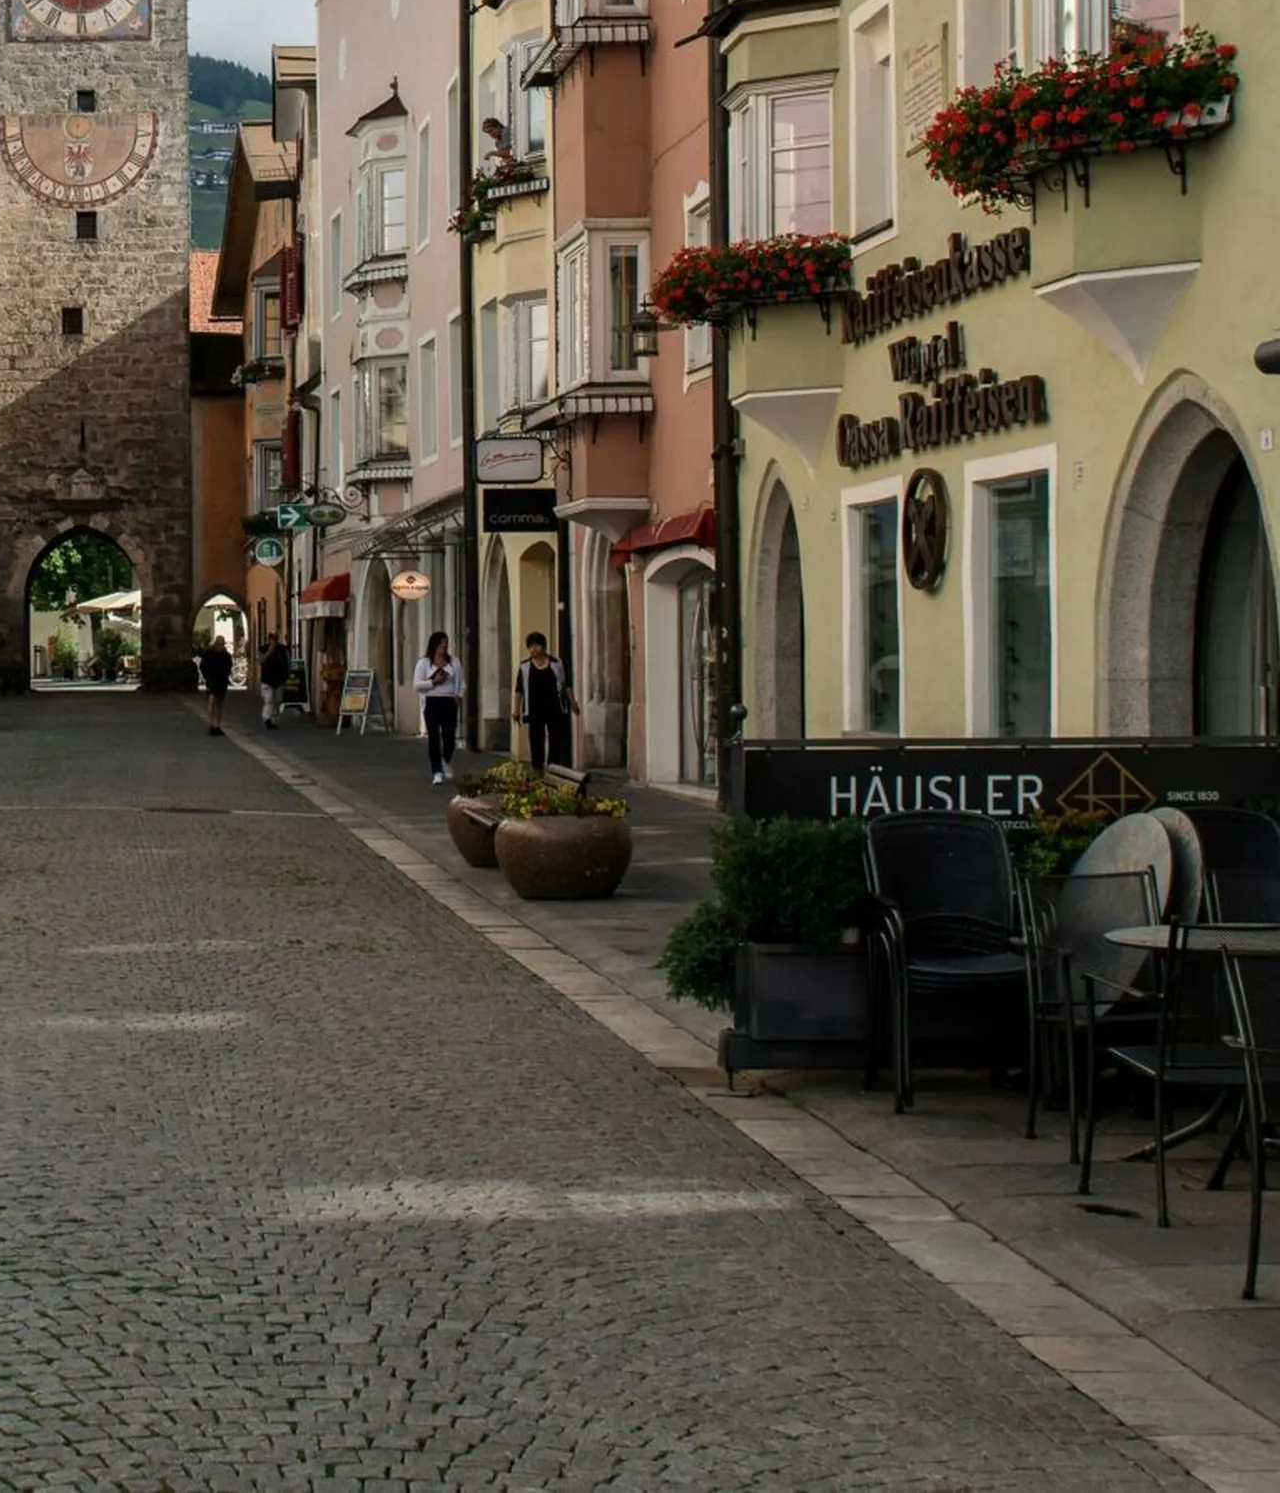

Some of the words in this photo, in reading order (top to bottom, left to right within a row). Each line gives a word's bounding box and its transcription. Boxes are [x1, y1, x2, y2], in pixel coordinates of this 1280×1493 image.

[836, 413, 900, 470] Cassa
[898, 367, 1051, 451] Raiffeisen
[830, 765, 1043, 816] HÄUSLER
[1167, 790, 1196, 802] SINCE
[1197, 790, 1219, 801] 1830
